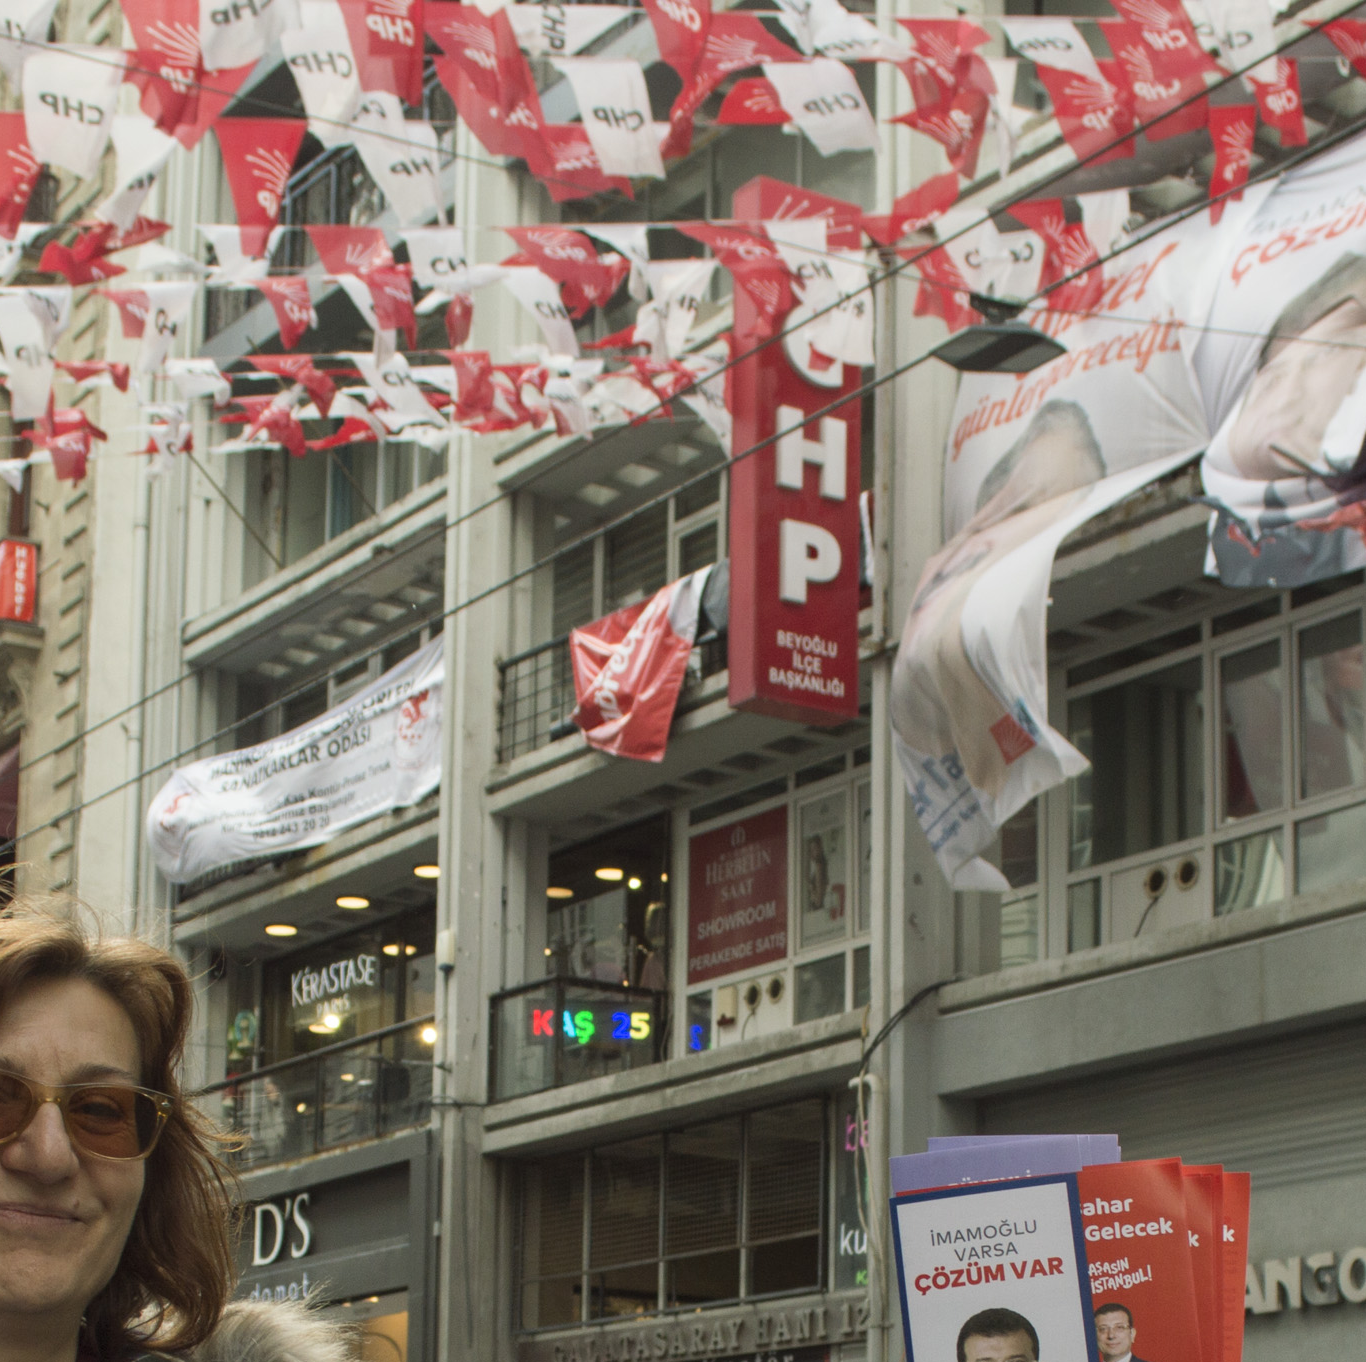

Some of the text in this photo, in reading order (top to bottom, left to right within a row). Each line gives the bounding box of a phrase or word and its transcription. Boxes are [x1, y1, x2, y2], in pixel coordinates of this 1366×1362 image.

[776, 629, 838, 658] BEYOĞLU
[792, 649, 822, 675] İLÇE
[769, 666, 845, 698] BAŞKANLIĞI
[697, 900, 776, 940] SHOWROOM
[689, 930, 787, 972] PERAKENDE SATIŞ
[291, 953, 378, 1008] KÉRASTASE
[611, 1011, 651, 1041] 25
[1079, 1197, 1134, 1217] ahar
[251, 1191, 311, 1267] D'S
[930, 1219, 1038, 1247] İMAMOĞLU
[1085, 1216, 1175, 1242] Gelecek
[953, 1241, 1018, 1262] VARSA
[914, 1256, 1065, 1297] ÇÖZÜM VAR
[1087, 1256, 1130, 1278] AŞASIN
[1090, 1264, 1153, 1295] İSTANBUL!
[754, 1305, 828, 1348] HANI
